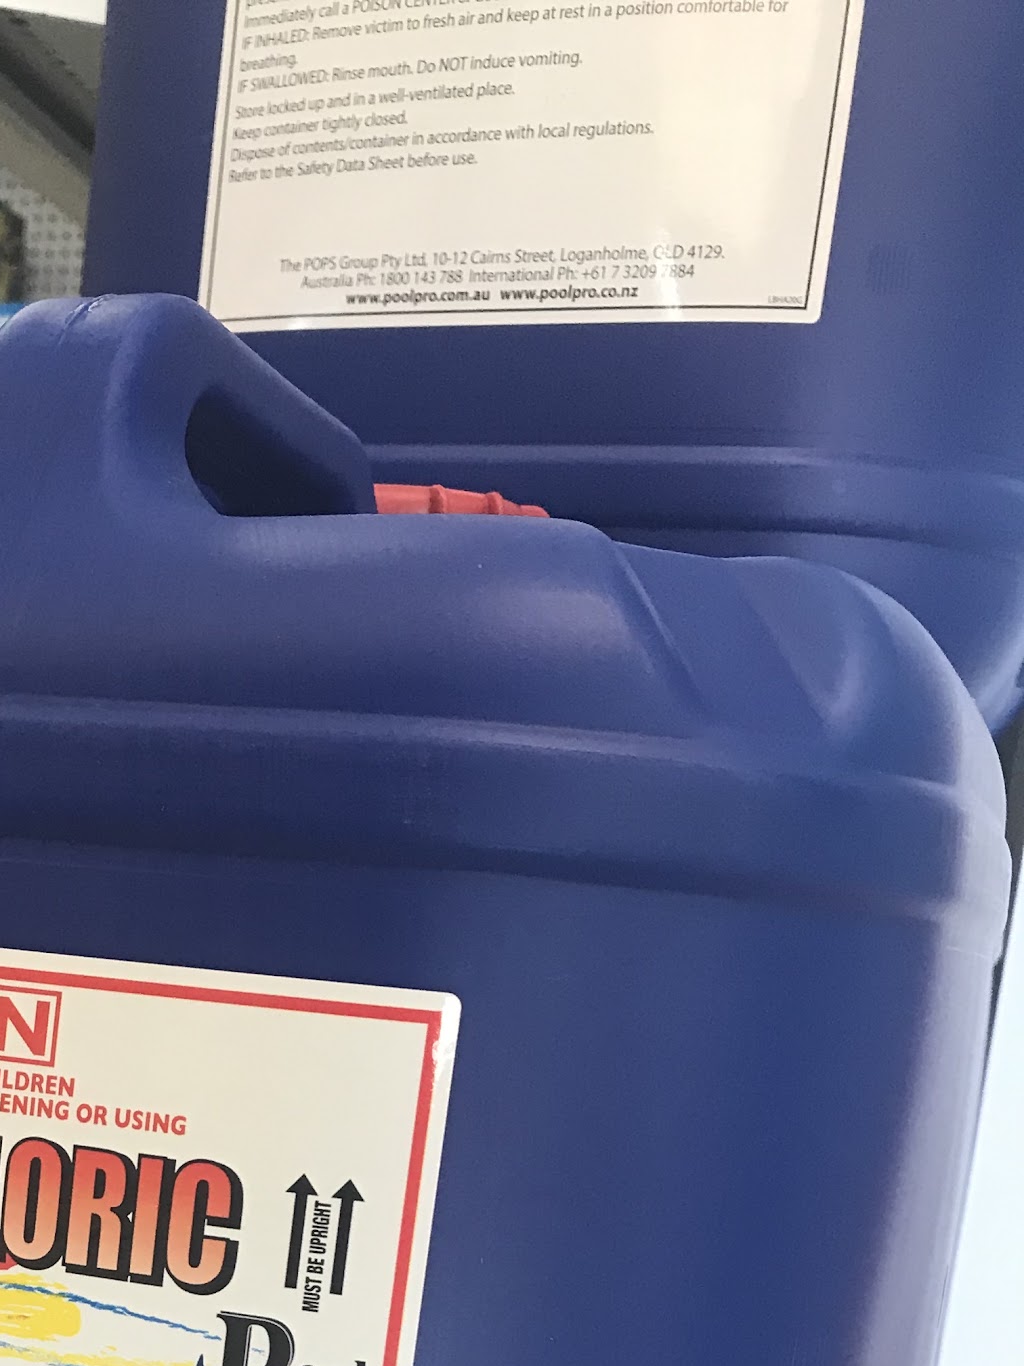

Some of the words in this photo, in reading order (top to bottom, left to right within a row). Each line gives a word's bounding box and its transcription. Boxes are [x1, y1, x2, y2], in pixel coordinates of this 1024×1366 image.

[76, 1103, 108, 1126] OR
[114, 1108, 187, 1136] USING
[308, 1200, 332, 1254] UPRIGHT
[306, 1257, 324, 1274] BE
[302, 1277, 323, 1313] MUST
